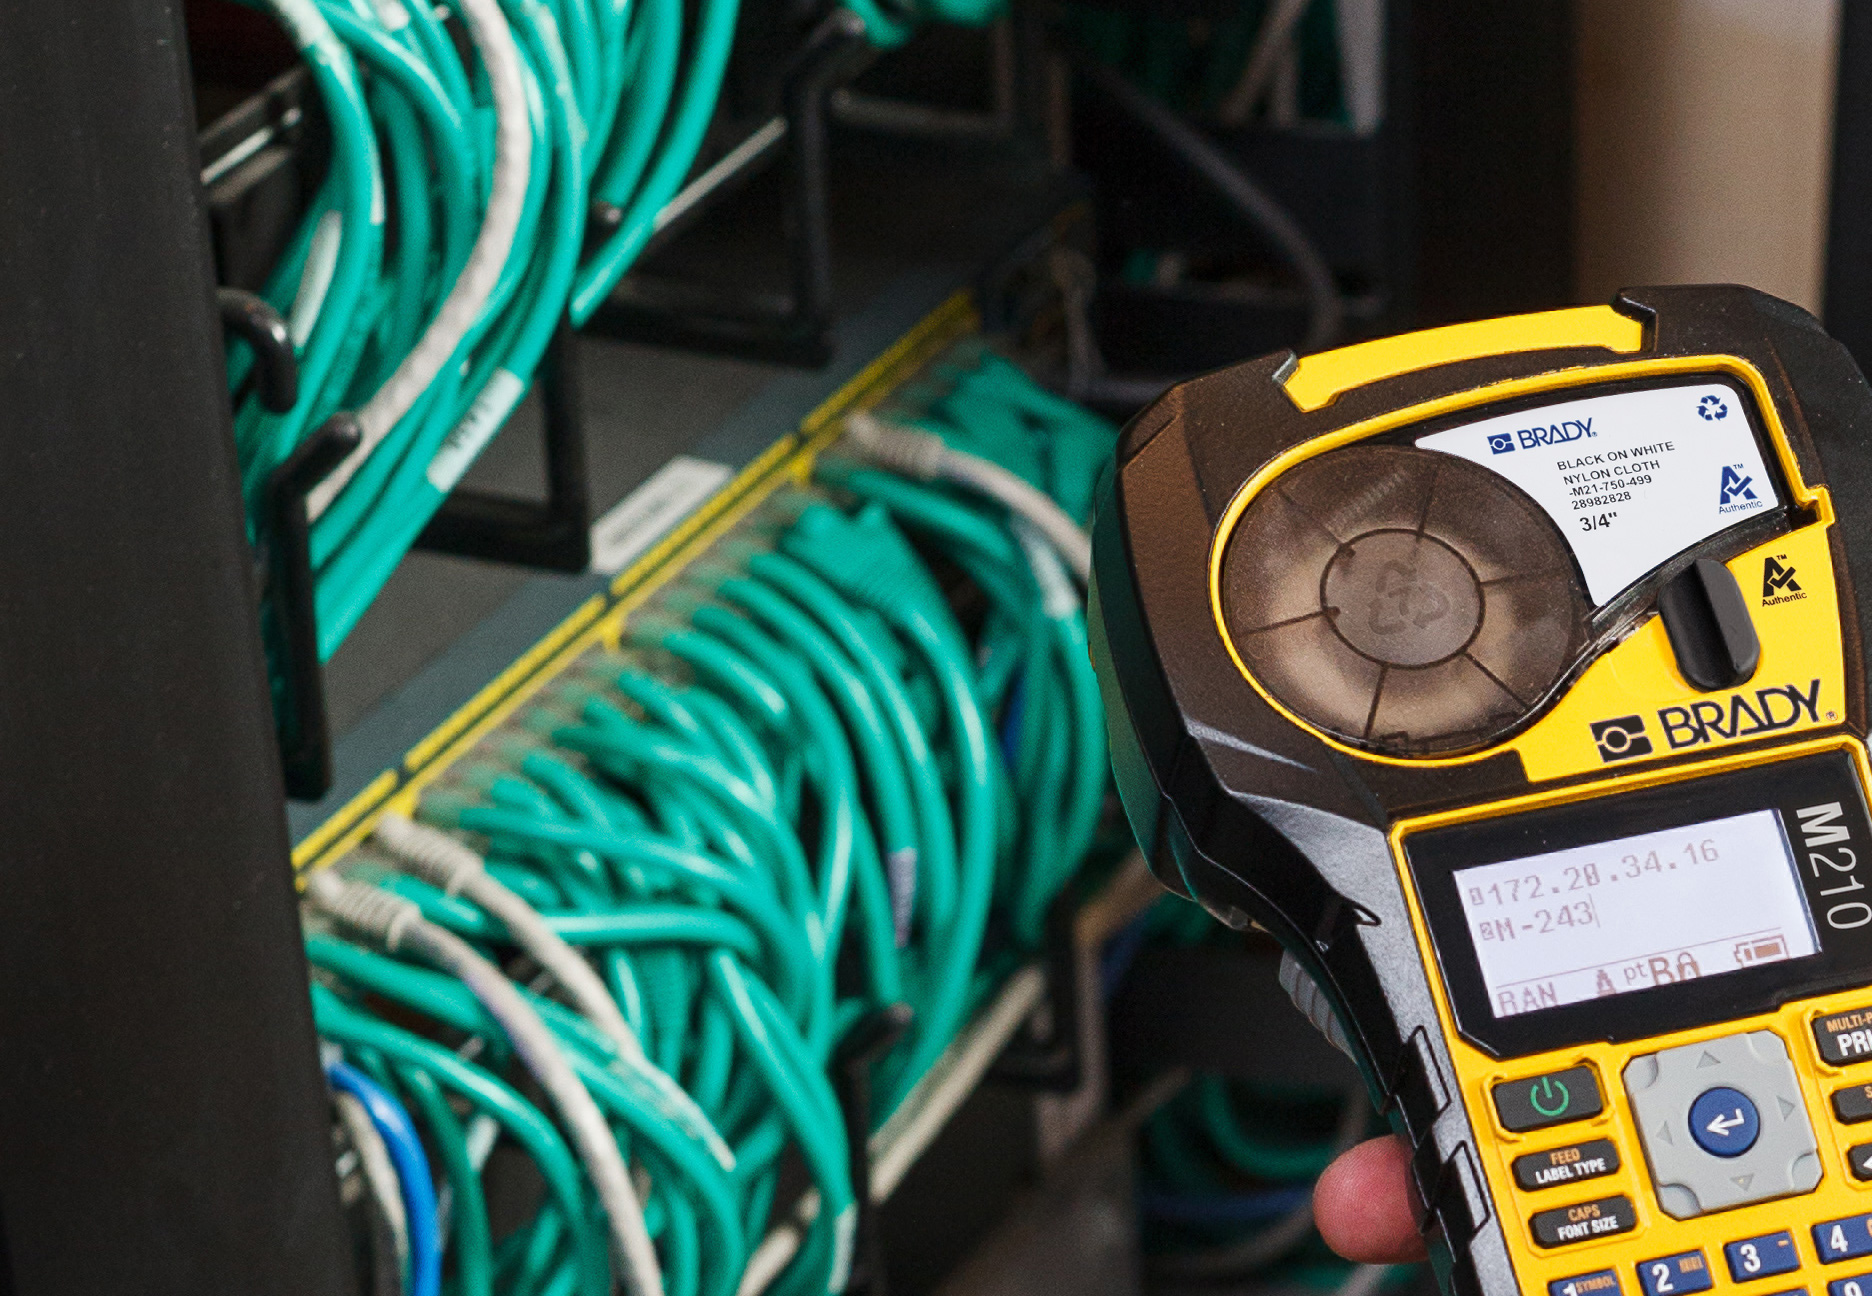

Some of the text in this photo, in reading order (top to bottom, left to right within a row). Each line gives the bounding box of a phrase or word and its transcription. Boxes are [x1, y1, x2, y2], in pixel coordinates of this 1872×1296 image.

[1516, 417, 1593, 450] BRADY
[1557, 441, 1676, 471] BLACK ON WHITE
[1563, 459, 1660, 485] NYLON CLOTH
[1568, 474, 1652, 497] -M21-750-499
[1571, 491, 1632, 510] 28982828
[1718, 499, 1763, 514] Authentic
[1579, 511, 1618, 532] 3/4"
[1762, 591, 1807, 607] Authentic
[1657, 679, 1820, 749] BRADY
[1796, 801, 1872, 930] M210
[1550, 1147, 1580, 1165] FEED
[1535, 1157, 1607, 1184] LABEL TYPE
[1567, 1203, 1601, 1221] CAPS
[1557, 1215, 1619, 1241] FONT SIZE
[1830, 1224, 1849, 1253] 4
[1740, 1243, 1761, 1273] 3
[1651, 1263, 1674, 1293] 2
